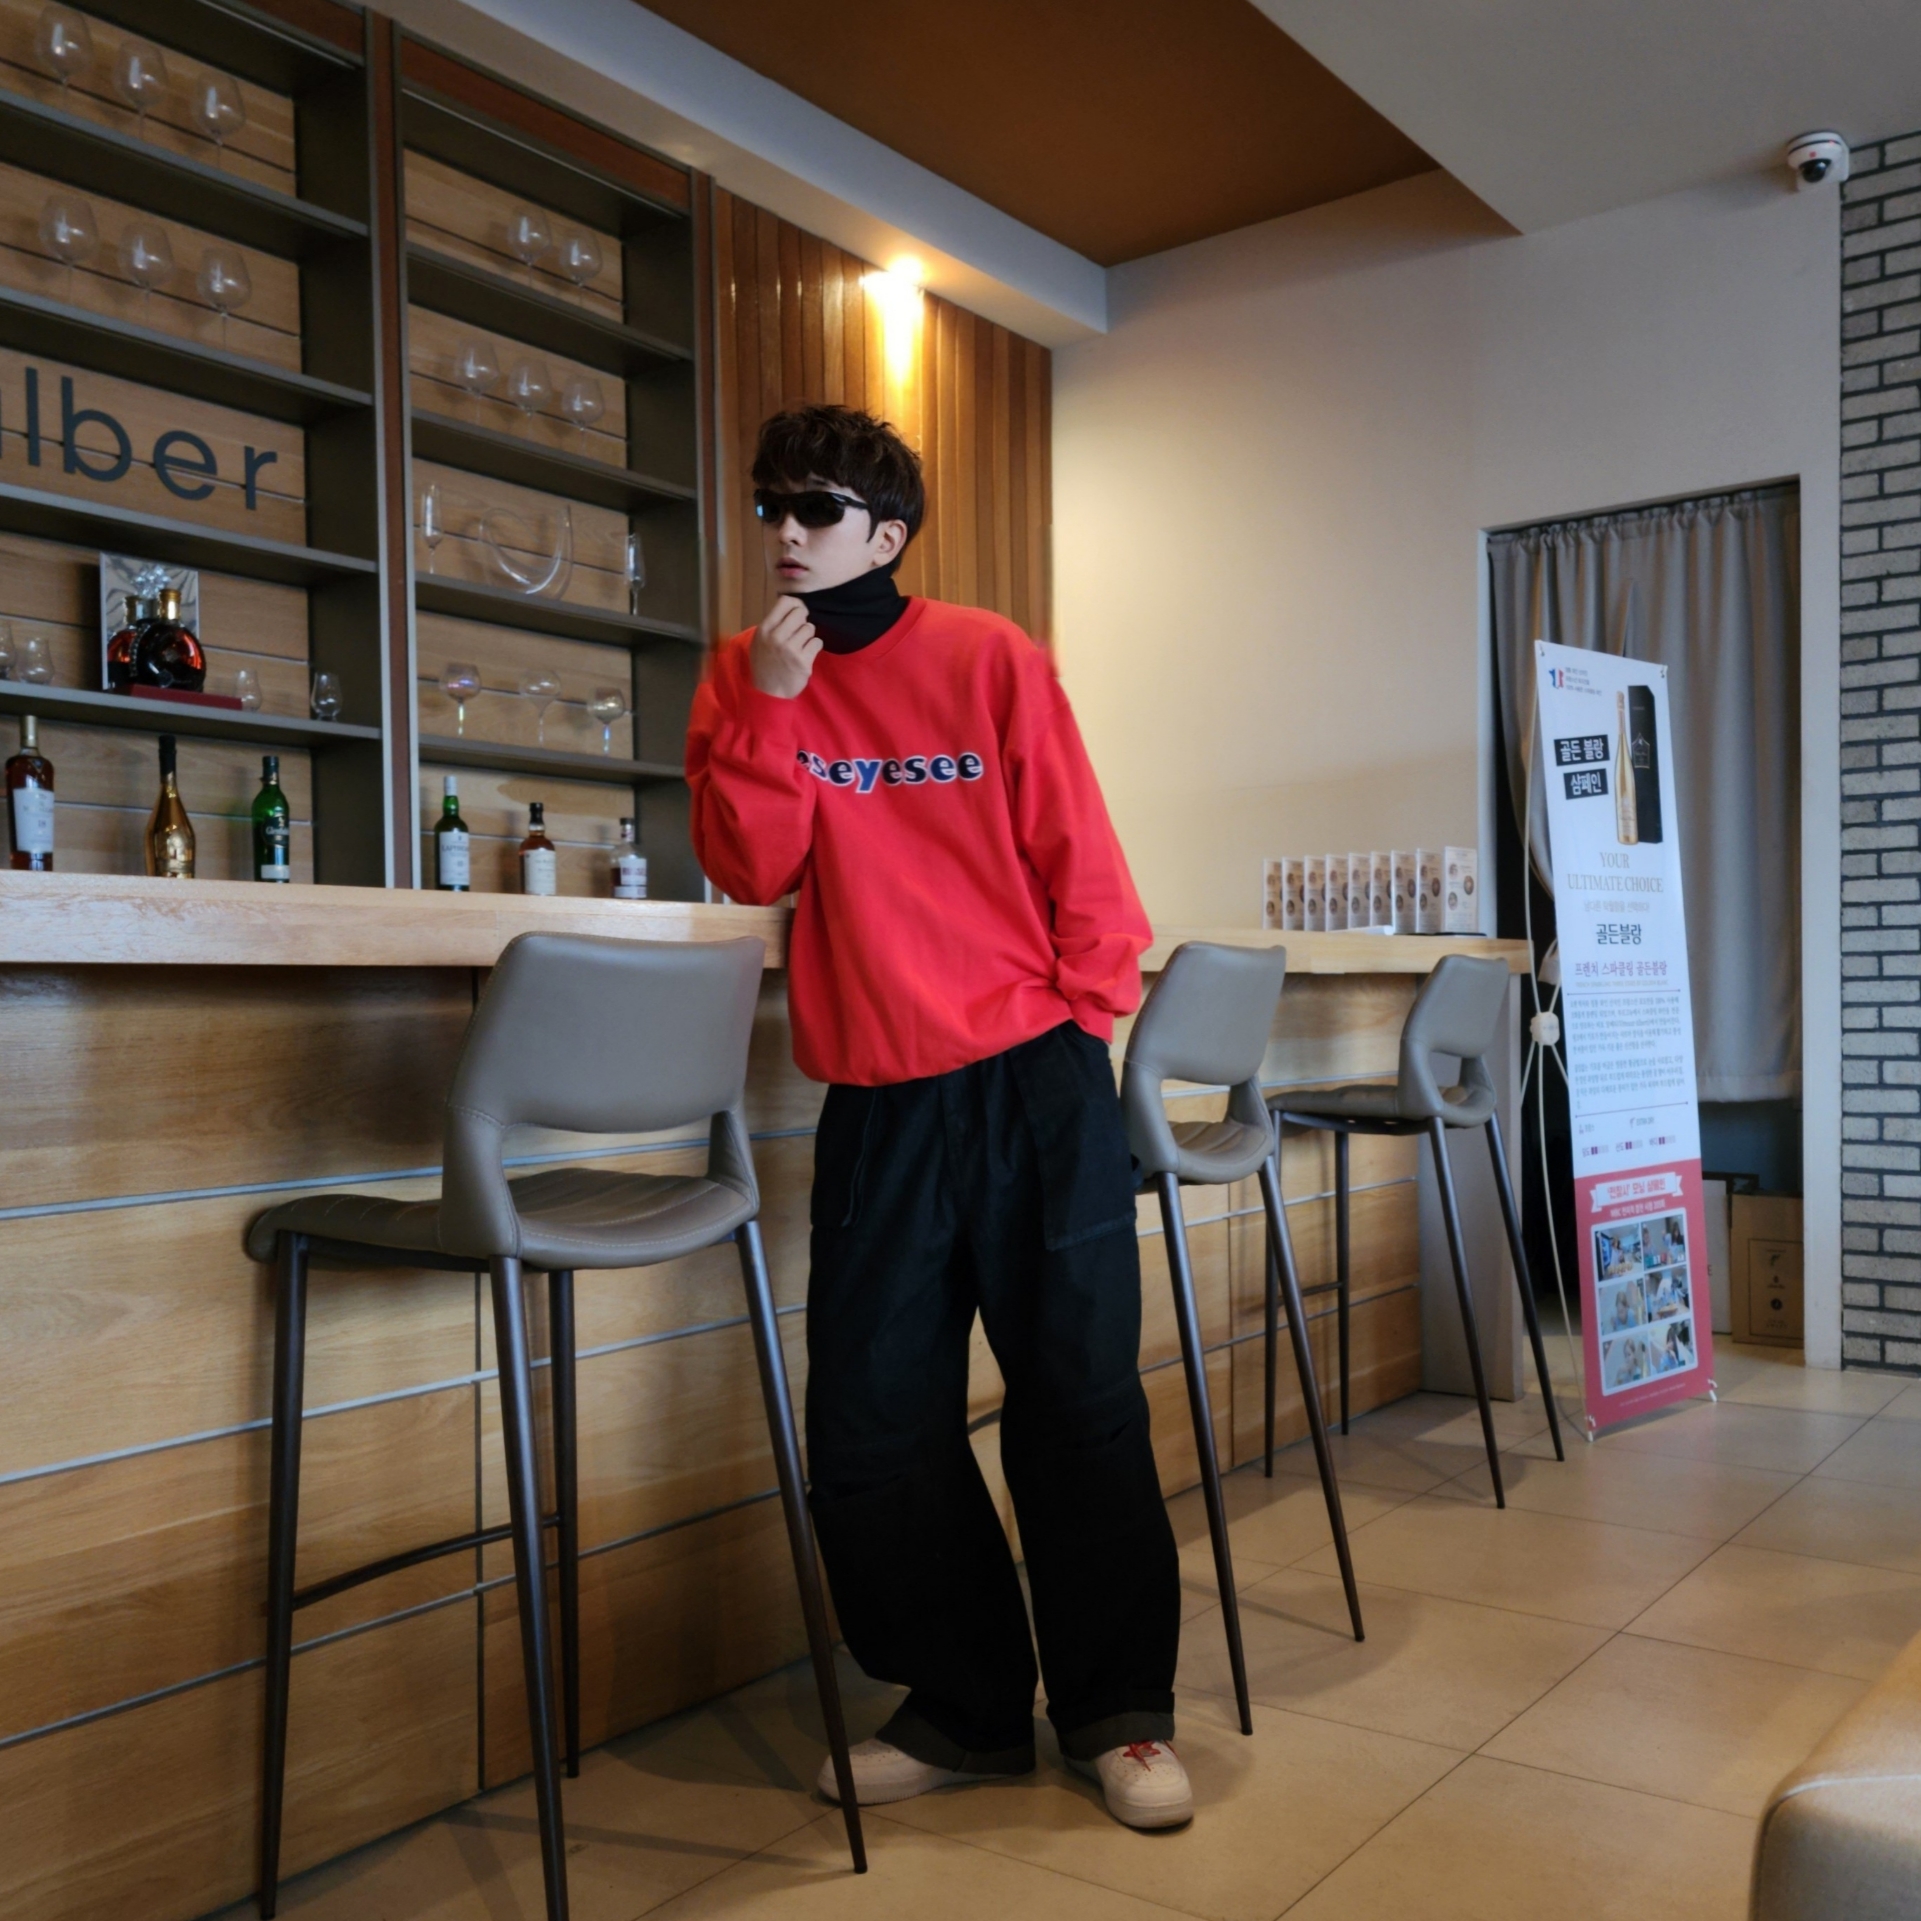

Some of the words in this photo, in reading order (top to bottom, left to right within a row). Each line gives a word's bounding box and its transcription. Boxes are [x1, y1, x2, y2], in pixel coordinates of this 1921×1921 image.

[0, 366, 278, 511] lber
[1559, 741, 1582, 762] 골든
[1583, 738, 1604, 759] 블랑
[1570, 774, 1602, 796] 샴페인
[1599, 852, 1630, 869] YOUR
[1567, 874, 1623, 892] ULTIMATE
[1624, 876, 1664, 893] CHOICE
[1596, 924, 1643, 945] 골든블랑
[1575, 961, 1599, 977] 프렌치
[1602, 961, 1633, 977] 스파클링
[1636, 961, 1668, 976] 골든블랑
